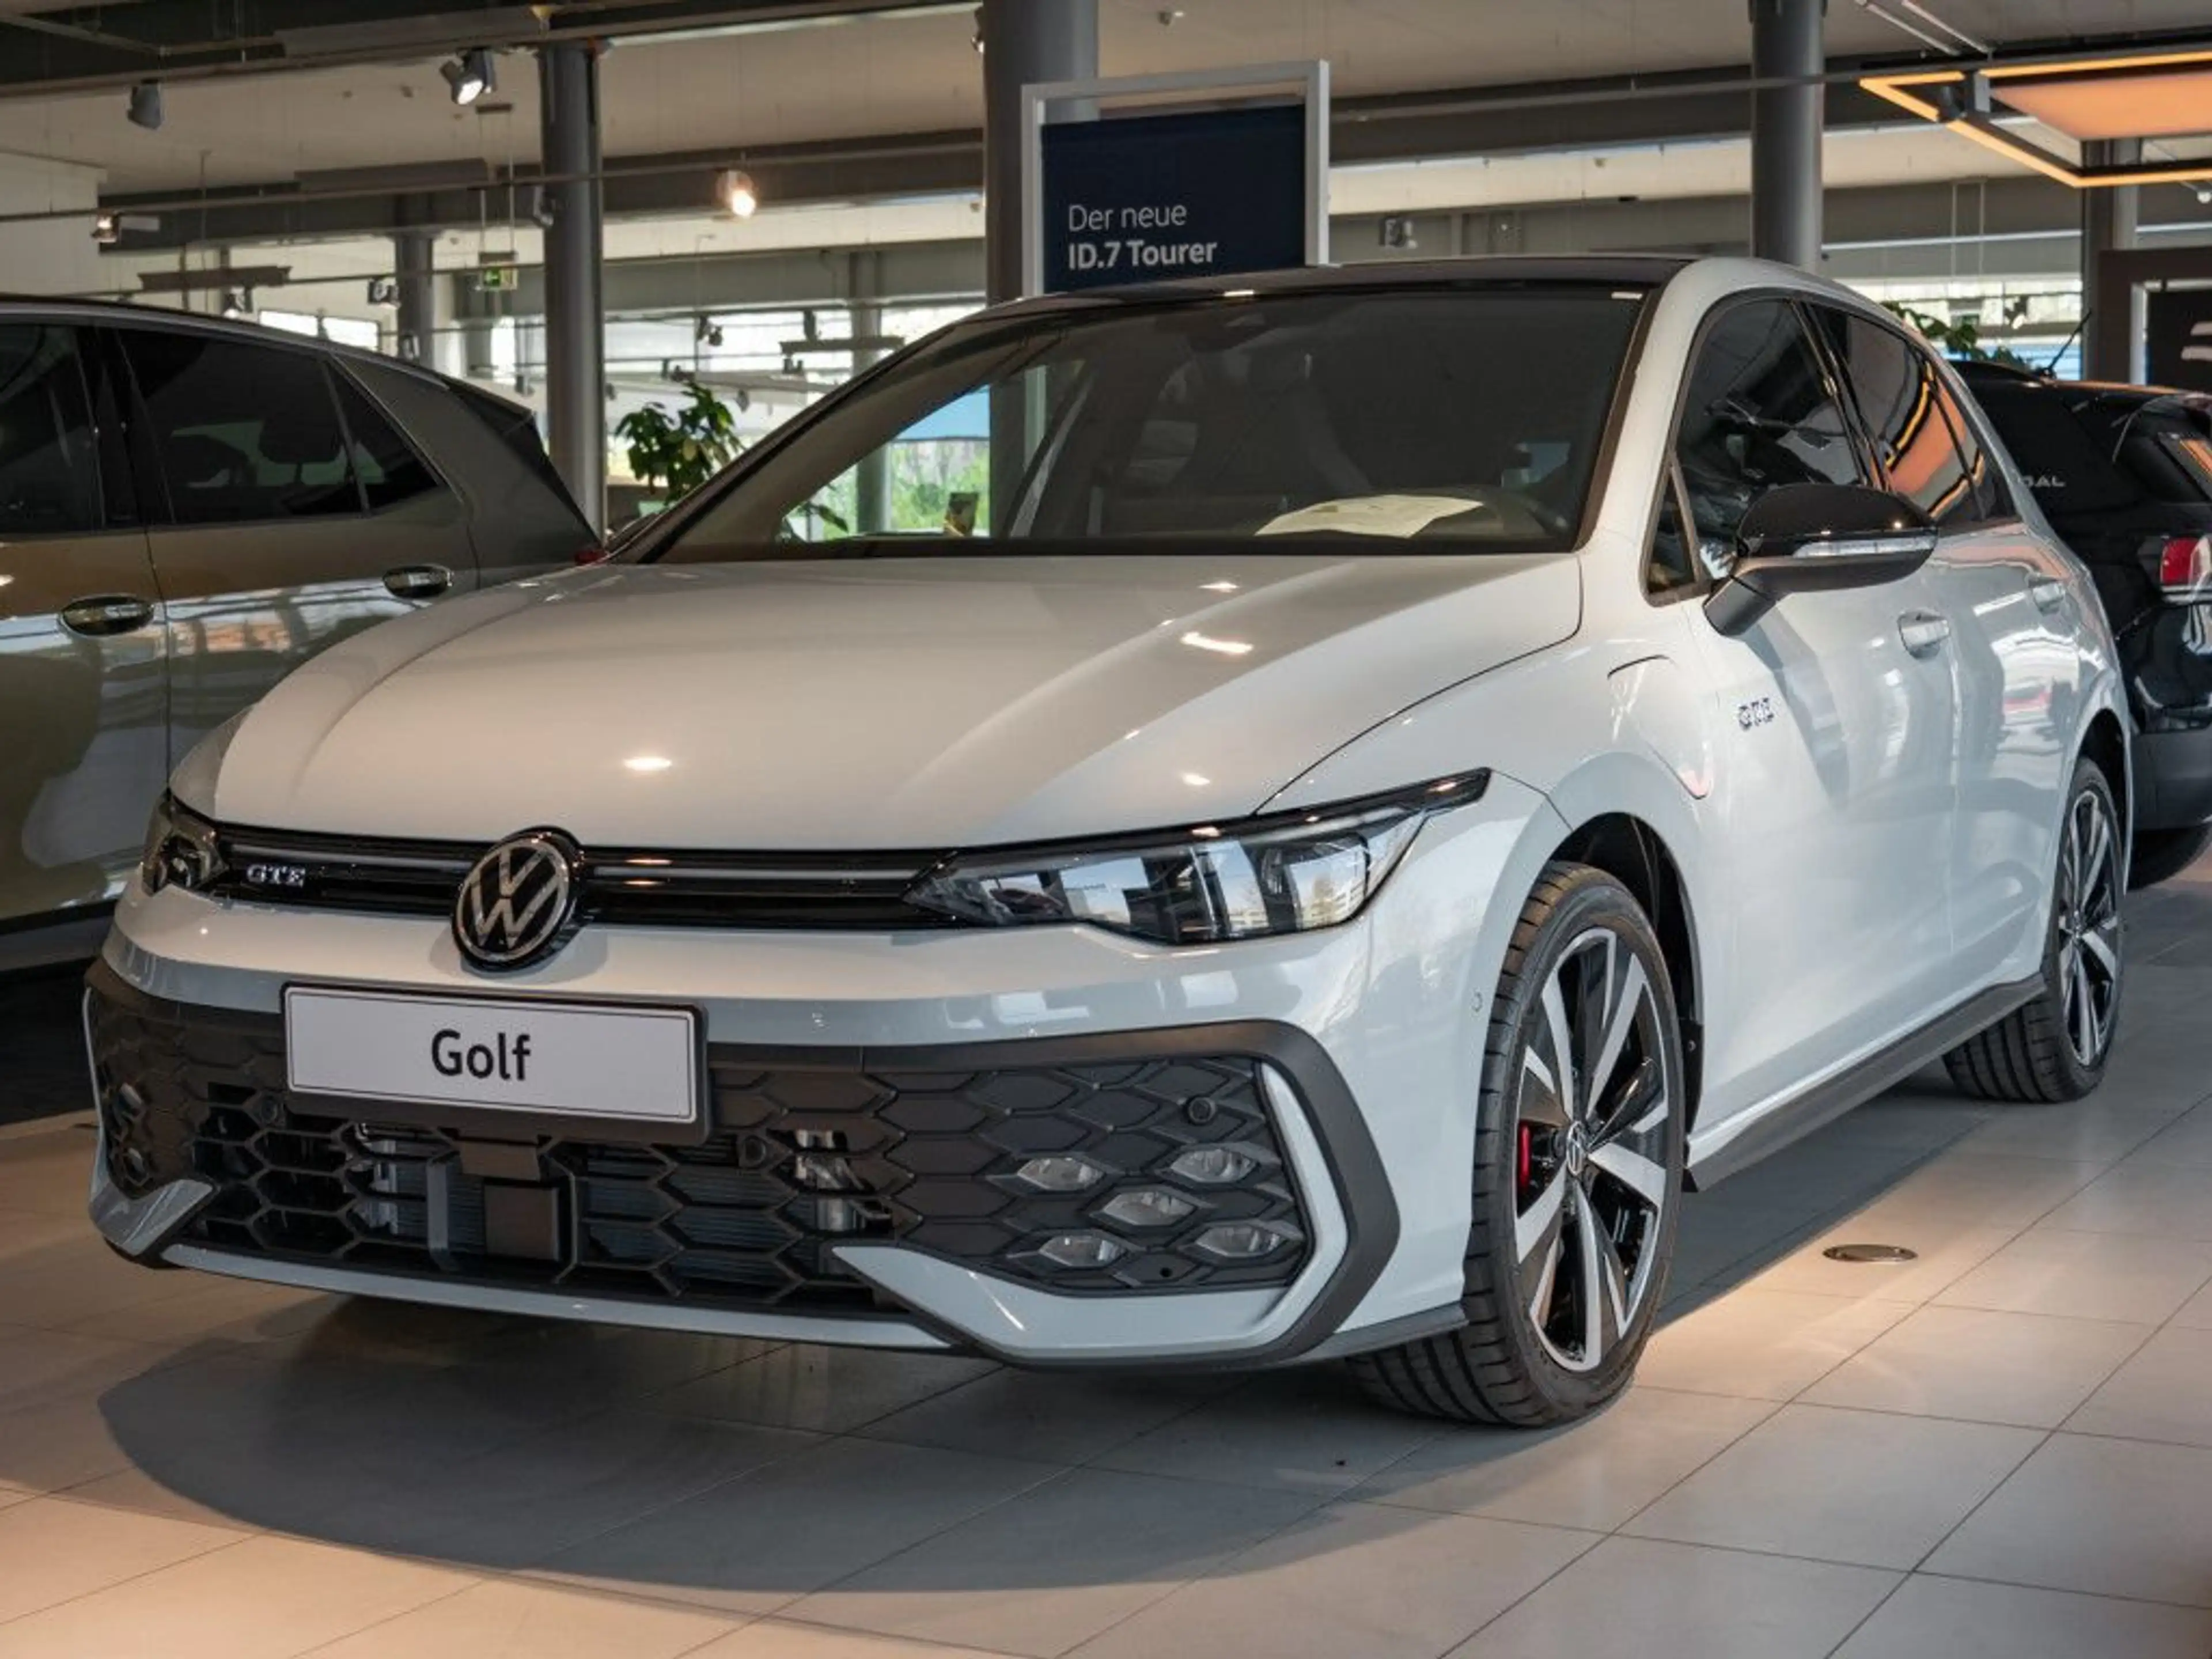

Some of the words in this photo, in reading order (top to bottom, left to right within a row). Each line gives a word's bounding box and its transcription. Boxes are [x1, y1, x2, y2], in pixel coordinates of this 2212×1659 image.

[1069, 204, 1113, 232] Der
[1121, 204, 1187, 229] neue
[1069, 240, 1122, 270] ID.7
[1125, 239, 1218, 267] Tourer
[431, 1028, 532, 1081] Golf
